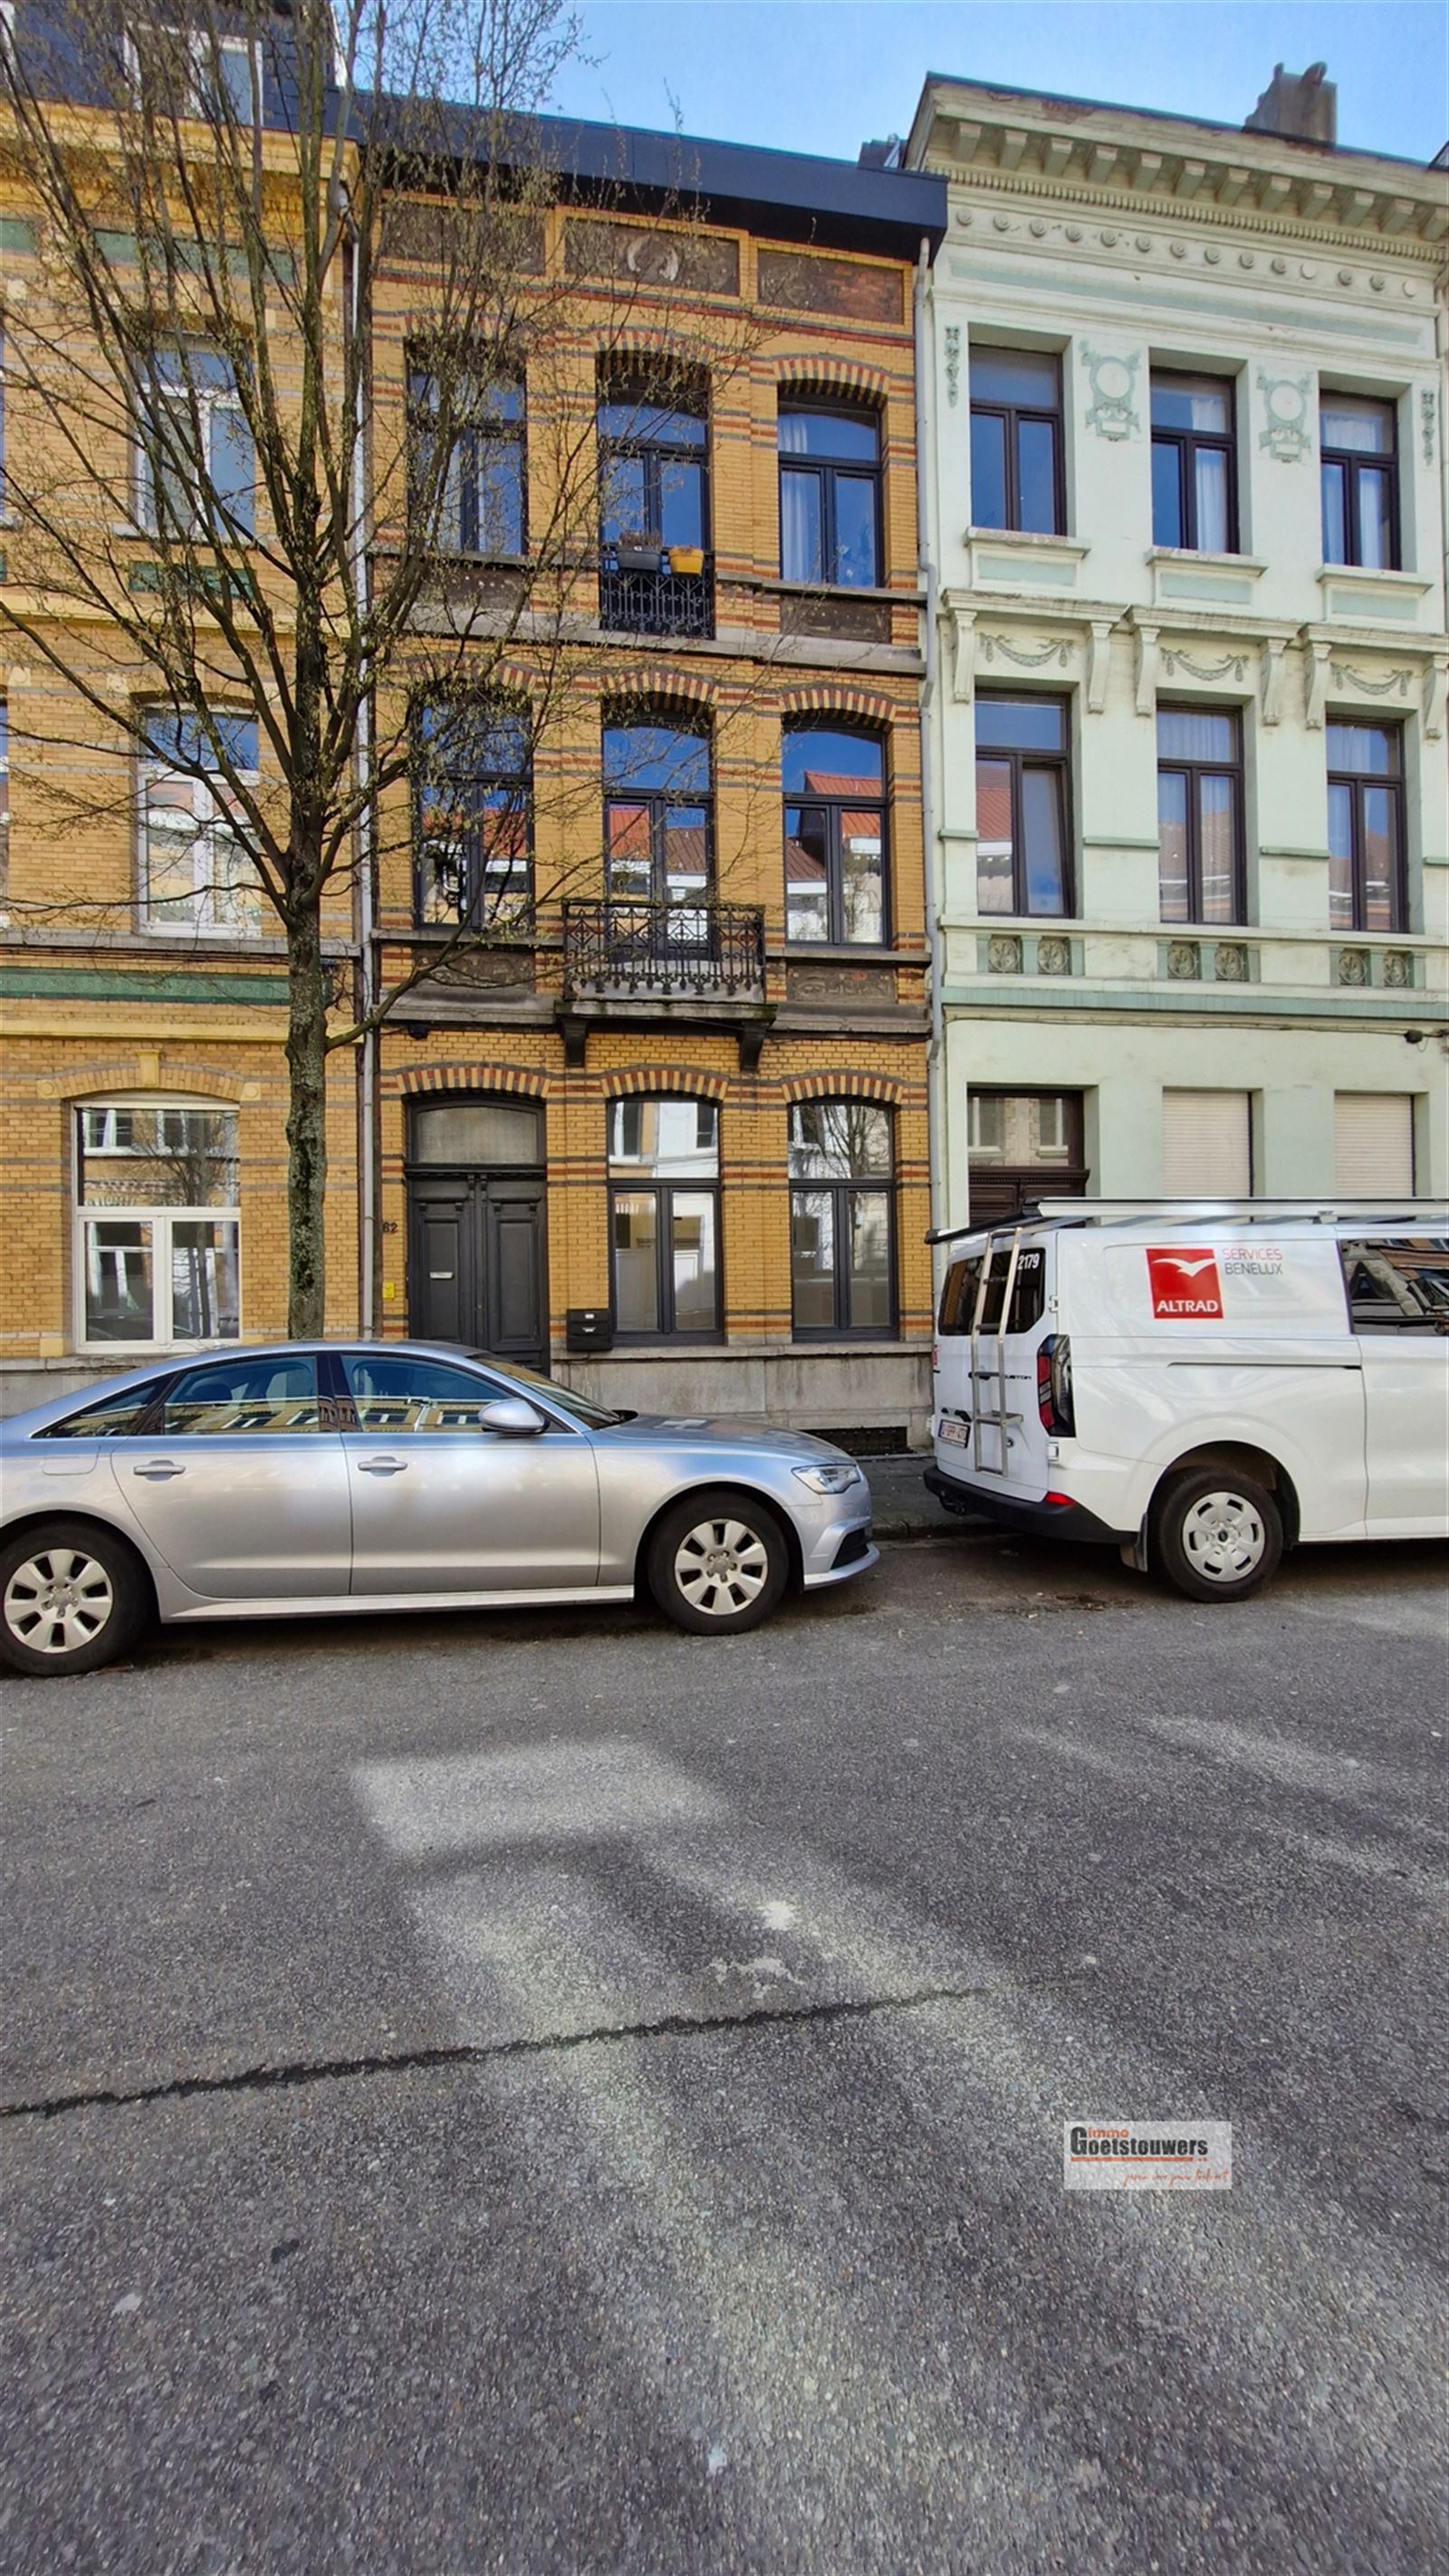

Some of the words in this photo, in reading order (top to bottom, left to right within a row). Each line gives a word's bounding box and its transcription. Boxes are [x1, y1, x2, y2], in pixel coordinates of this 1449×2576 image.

[382, 1221, 398, 1234] 62
[1223, 1248, 1283, 1261] SERVICES
[1017, 1253, 1041, 1270] 2179
[1224, 1263, 1284, 1275] BENELUX
[1156, 1300, 1219, 1313] ALTRAD
